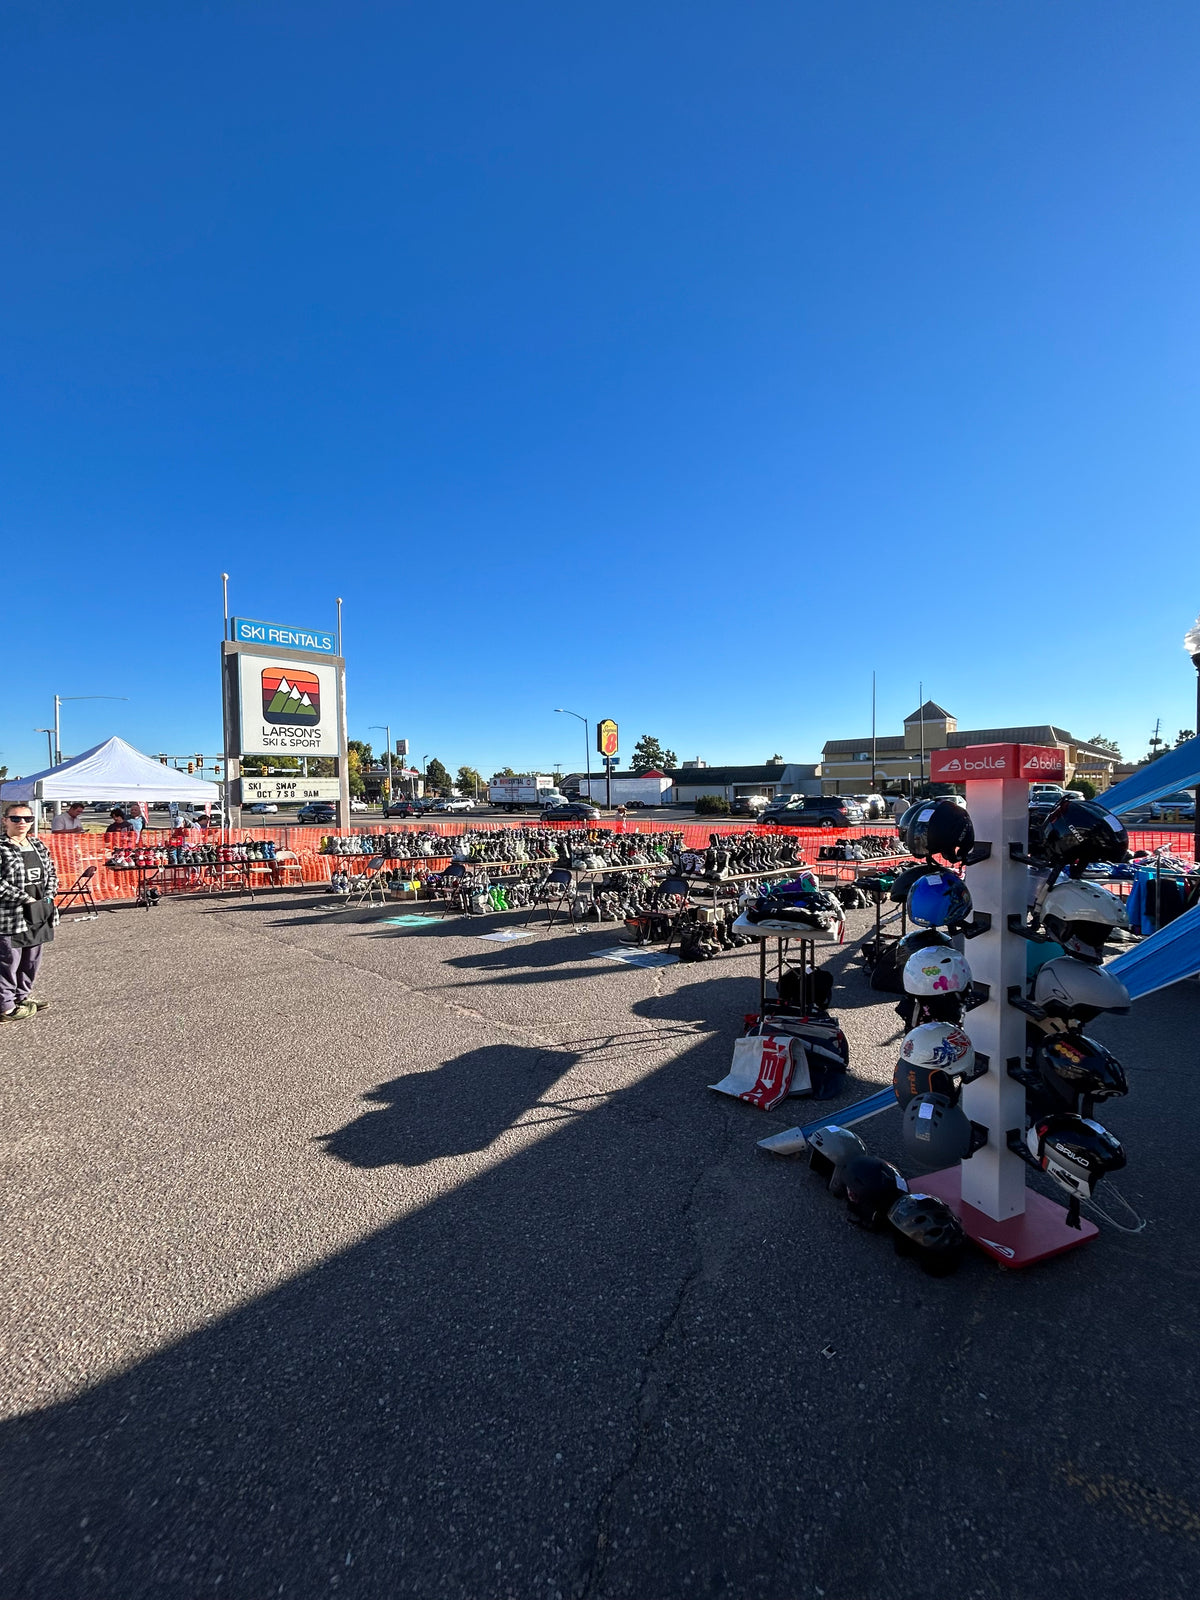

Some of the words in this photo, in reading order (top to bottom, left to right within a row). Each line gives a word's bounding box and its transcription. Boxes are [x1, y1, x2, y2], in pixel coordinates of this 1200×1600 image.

[241, 624, 265, 640] SKI
[269, 628, 332, 650] RENTALS
[262, 725, 322, 739] LARSON'S
[262, 738, 278, 747] SKI
[280, 738, 288, 747] &
[289, 738, 322, 748] SPORT
[605, 733, 616, 753] 8
[964, 755, 1007, 771] bollé
[1039, 757, 1063, 771] bollé
[248, 782, 262, 791] SKI
[276, 782, 297, 791] SWAP
[256, 790, 273, 798] OCT
[277, 790, 282, 798] 7
[290, 790, 296, 798] 8
[303, 790, 319, 798] 9AM
[1068, 824, 1085, 843] GIRO
[1055, 1143, 1090, 1168] BRIKO
